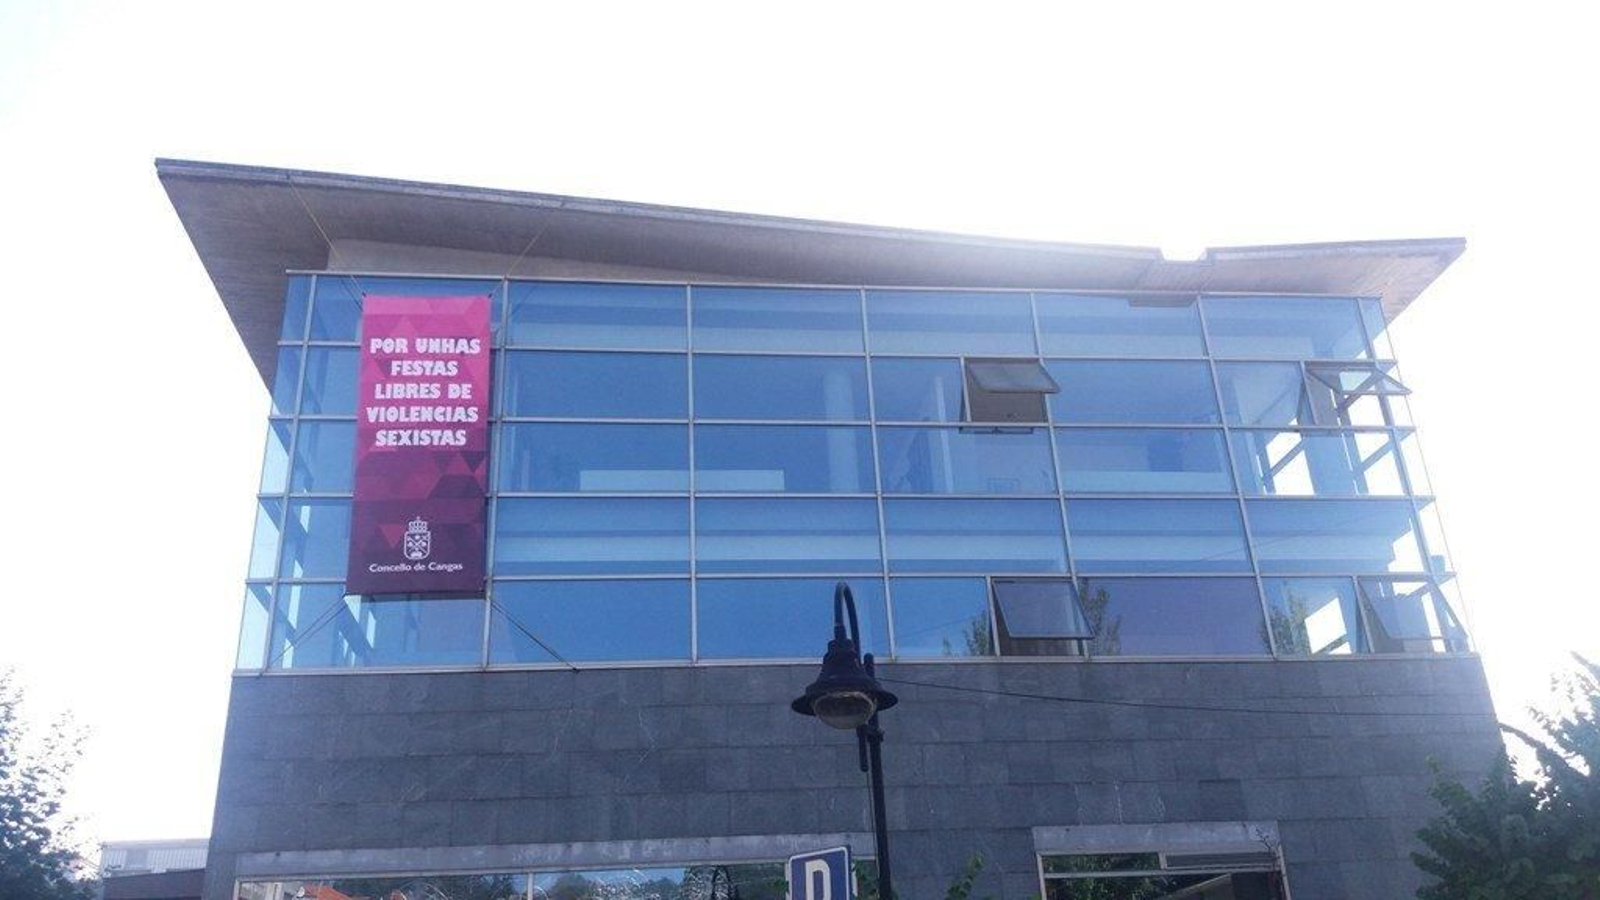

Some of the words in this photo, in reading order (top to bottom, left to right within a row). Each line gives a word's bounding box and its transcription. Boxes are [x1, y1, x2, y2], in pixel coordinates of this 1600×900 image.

[370, 338, 408, 354] POR
[415, 338, 481, 354] UNHAS
[391, 360, 458, 376] FESTAS
[374, 383, 441, 399] LIBRES
[447, 383, 472, 399] DE
[366, 406, 479, 422] VIOLENCIAS
[375, 429, 467, 446] SEXISTAS
[369, 563, 412, 573] Concello
[413, 562, 426, 571] de
[428, 562, 463, 572] Cangas
